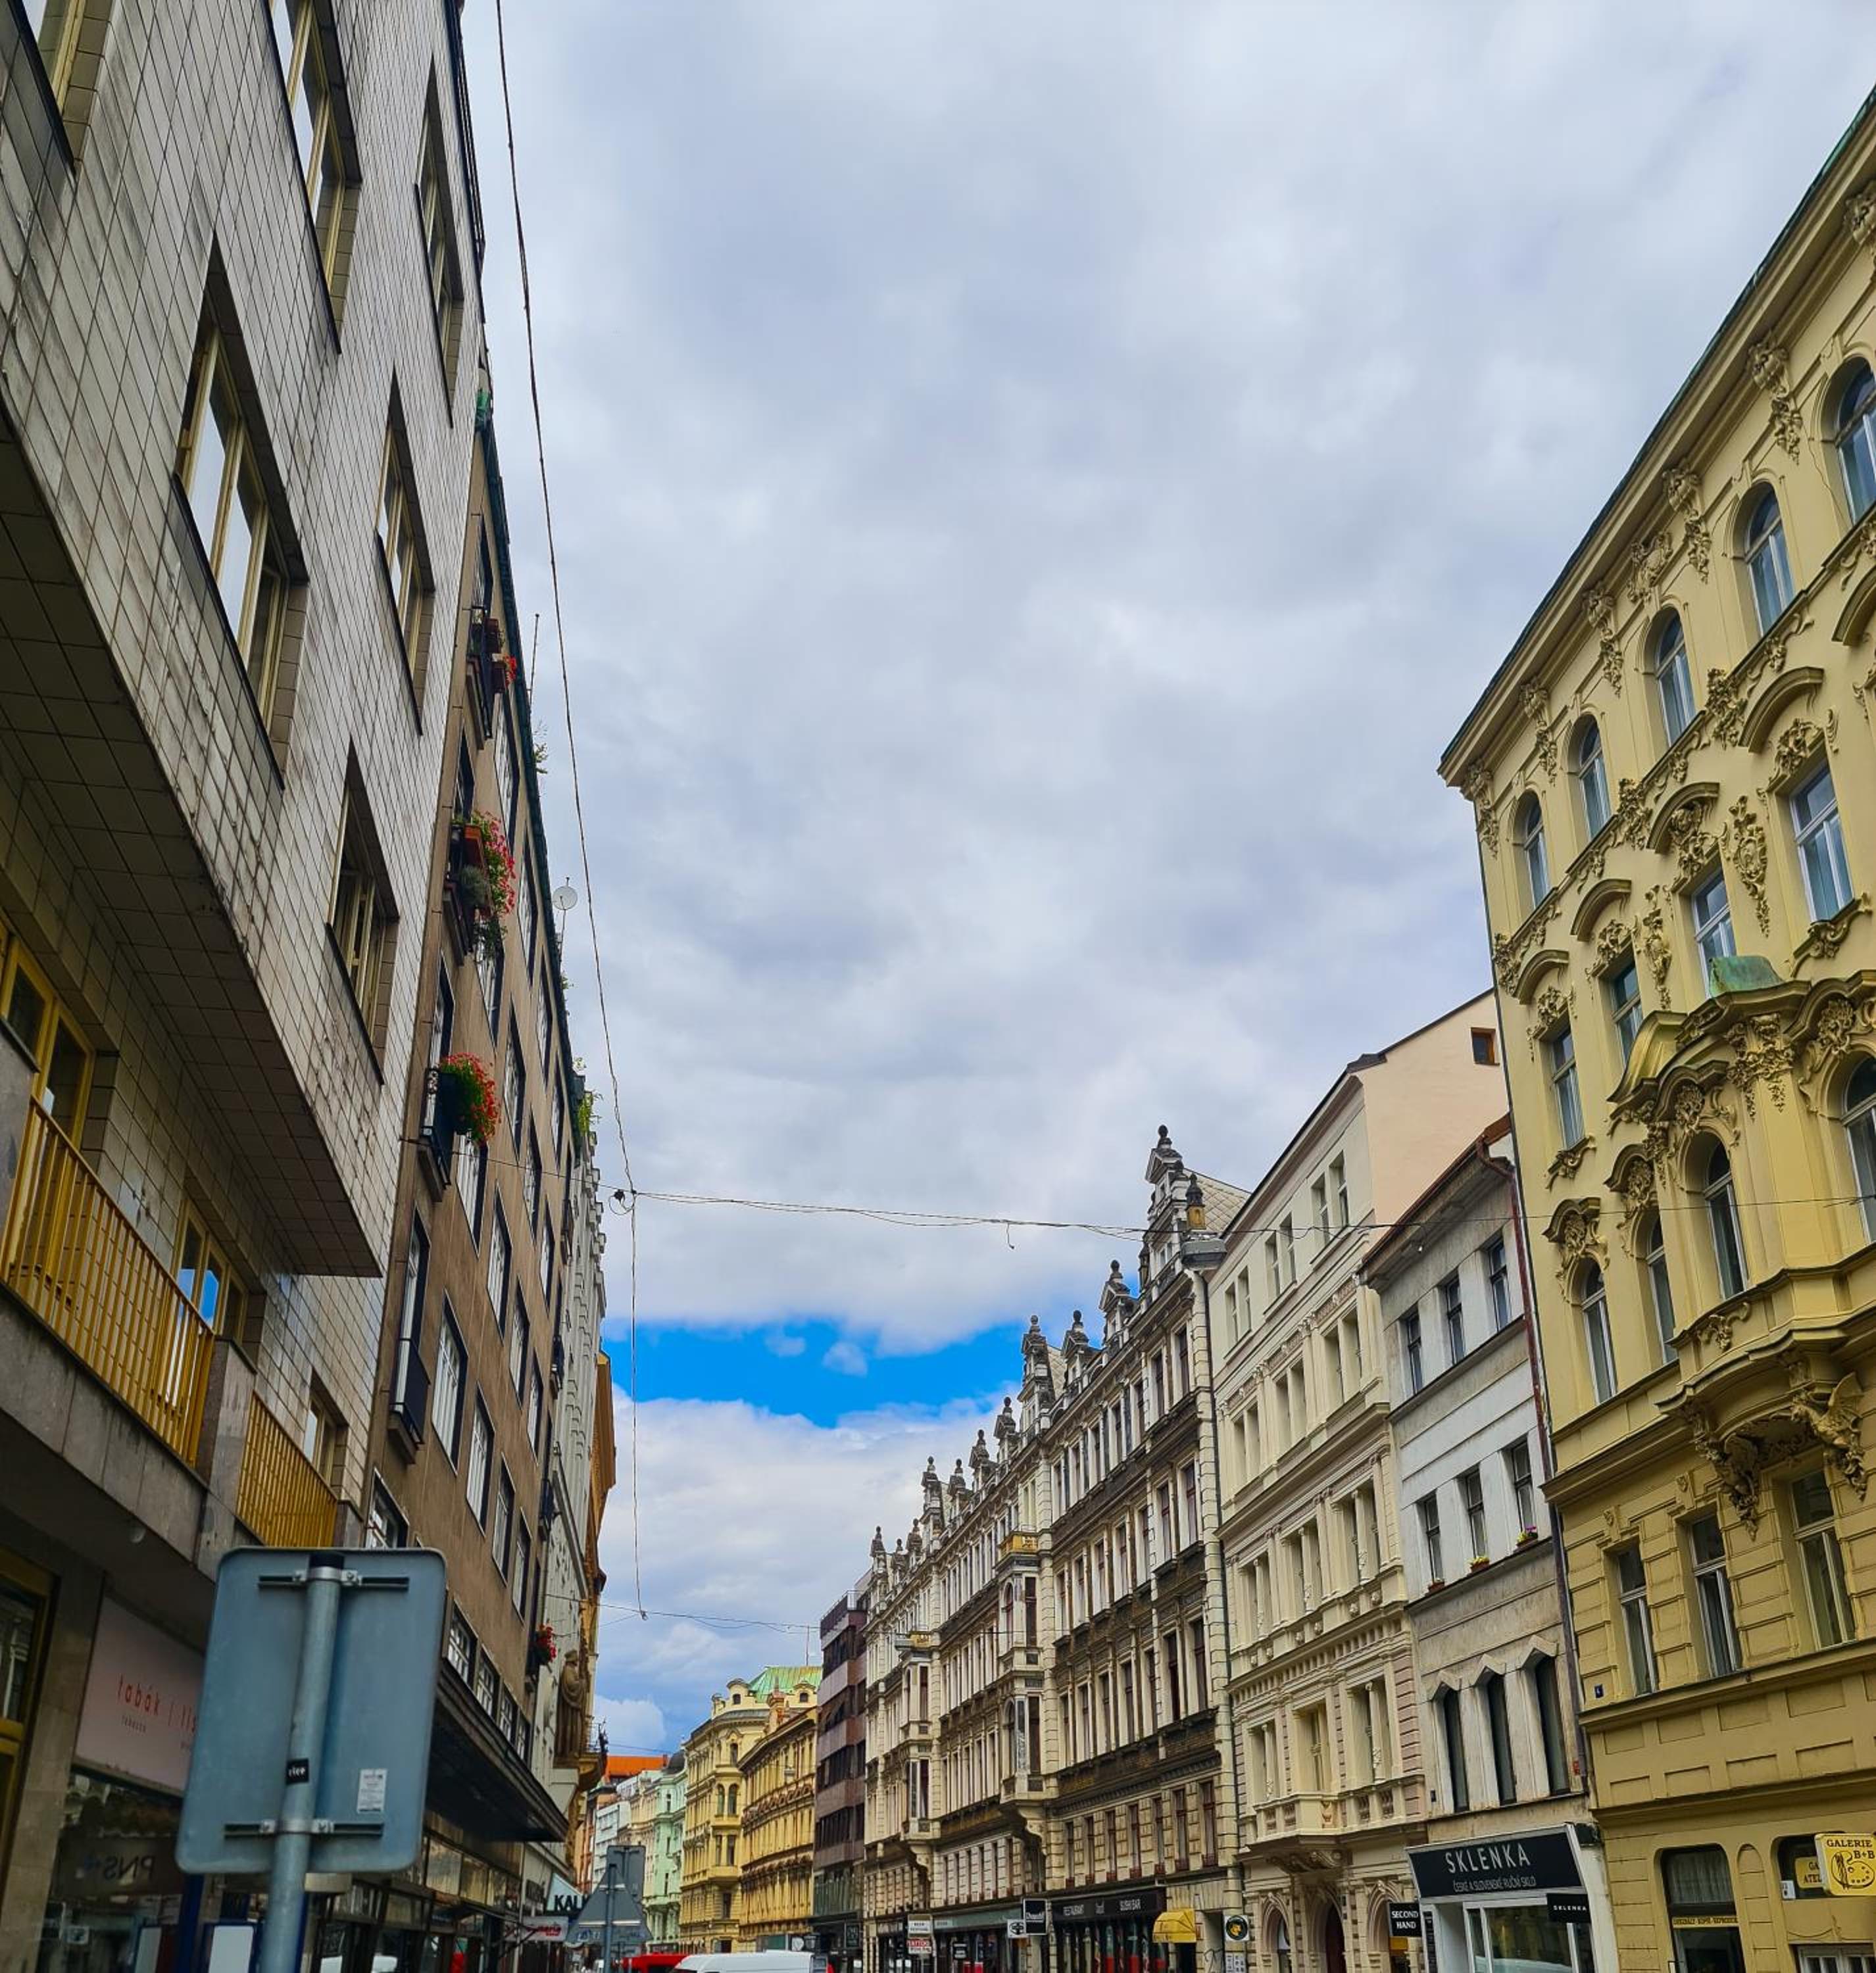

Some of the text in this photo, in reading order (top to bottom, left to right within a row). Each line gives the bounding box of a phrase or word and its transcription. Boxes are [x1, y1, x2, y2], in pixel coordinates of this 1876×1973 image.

[1446, 1842, 1531, 1874] SKLENKA
[1853, 1850, 1875, 1859] B+B
[1804, 1874, 1822, 1883] ATEL
[1396, 1920, 1416, 1929] HAND
